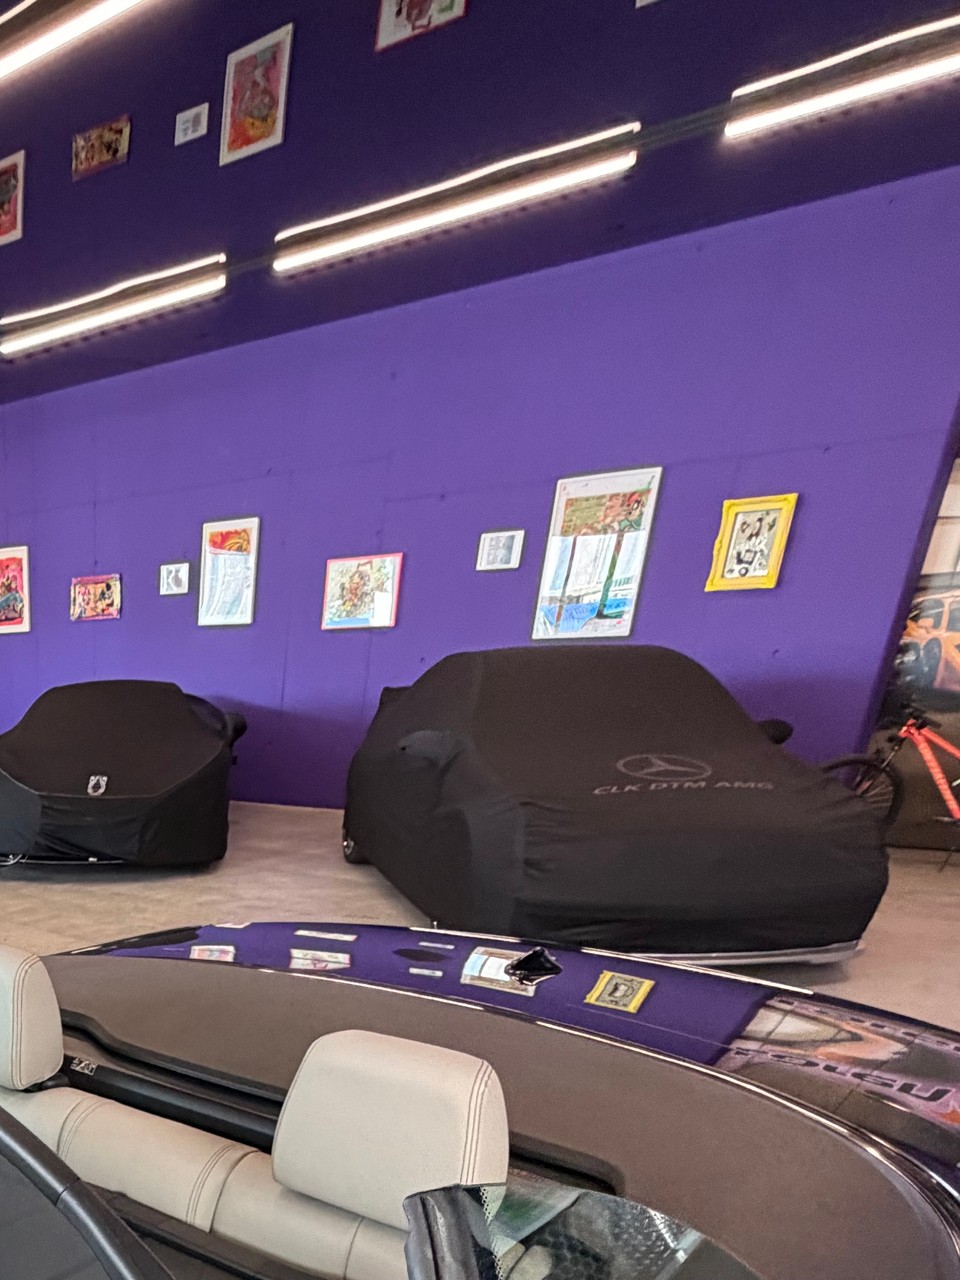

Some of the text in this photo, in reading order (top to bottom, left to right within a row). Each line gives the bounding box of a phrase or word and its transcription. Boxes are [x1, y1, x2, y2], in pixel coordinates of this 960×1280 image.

[592, 781, 775, 795] CLK DTM AMG
